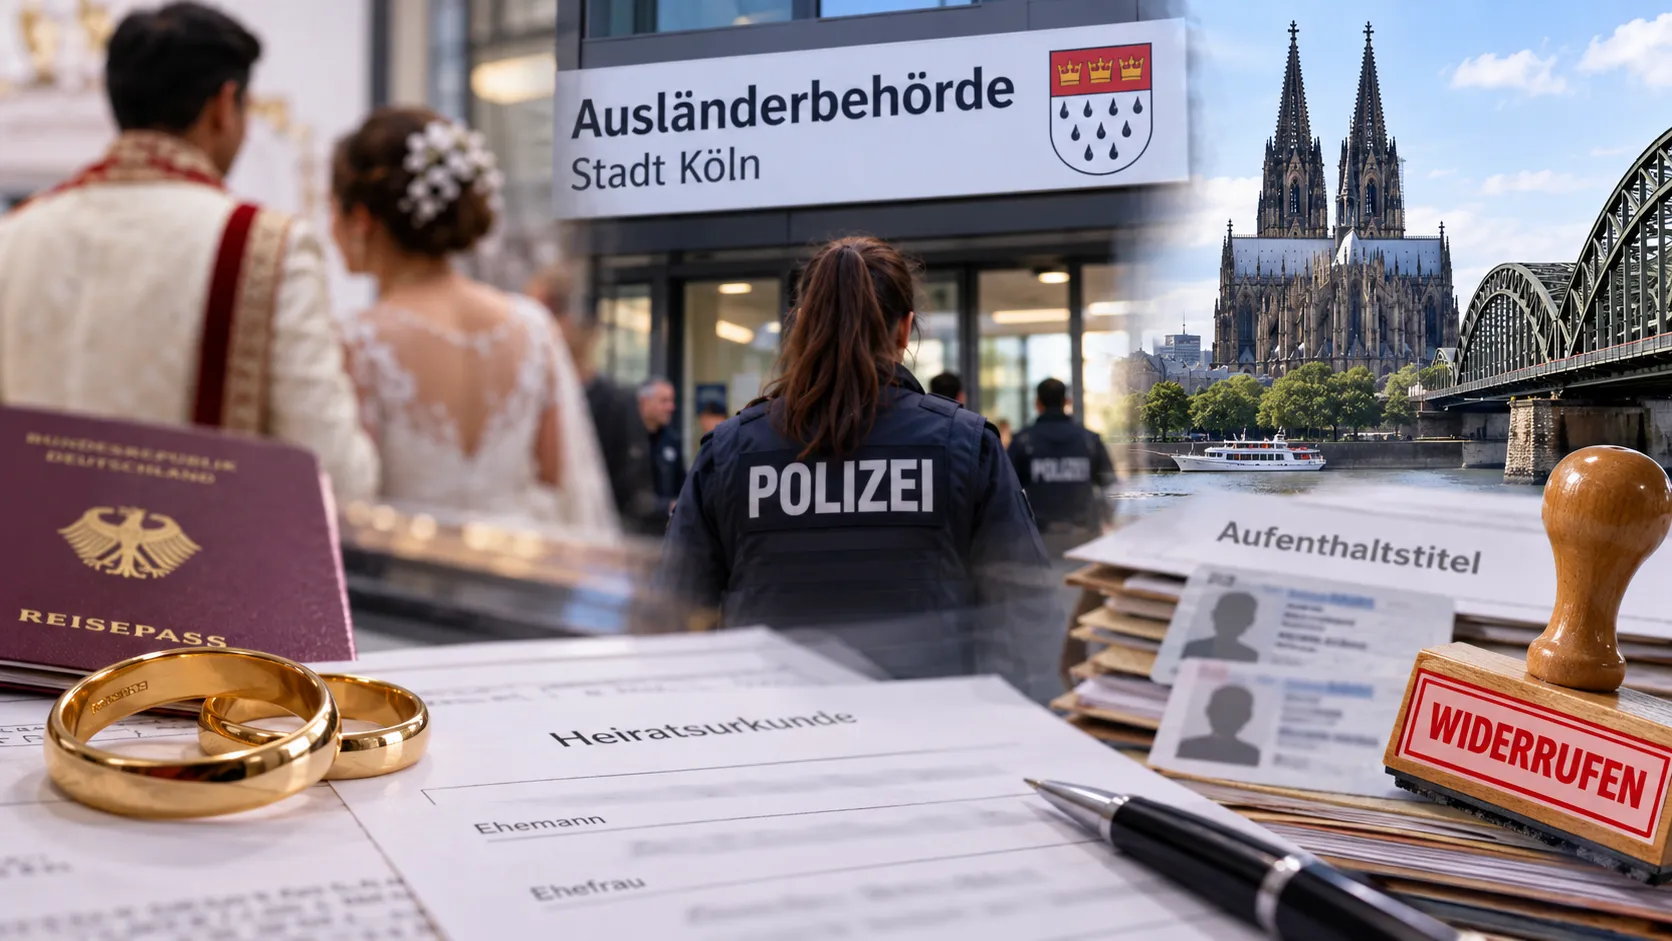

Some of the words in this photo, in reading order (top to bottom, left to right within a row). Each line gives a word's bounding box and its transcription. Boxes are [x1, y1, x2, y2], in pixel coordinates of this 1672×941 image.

[571, 66, 1015, 139] Ausländerbehörde
[571, 152, 666, 191] Stadt
[680, 147, 761, 184] Köln
[26, 431, 238, 473] BUNDESREPUBLIK
[45, 450, 216, 485] DEUTSCHLAND
[1030, 457, 1091, 483] POLIZEI
[748, 458, 934, 519] POLIZEI
[1217, 520, 1482, 575] Aufenthaltstitel
[18, 608, 229, 648] REISEPASS
[549, 709, 858, 748] Heiratsurkunde
[1428, 702, 1647, 809] WIDERRUFEN
[473, 811, 607, 835] Ehemann
[529, 873, 646, 903] Ehefrau
